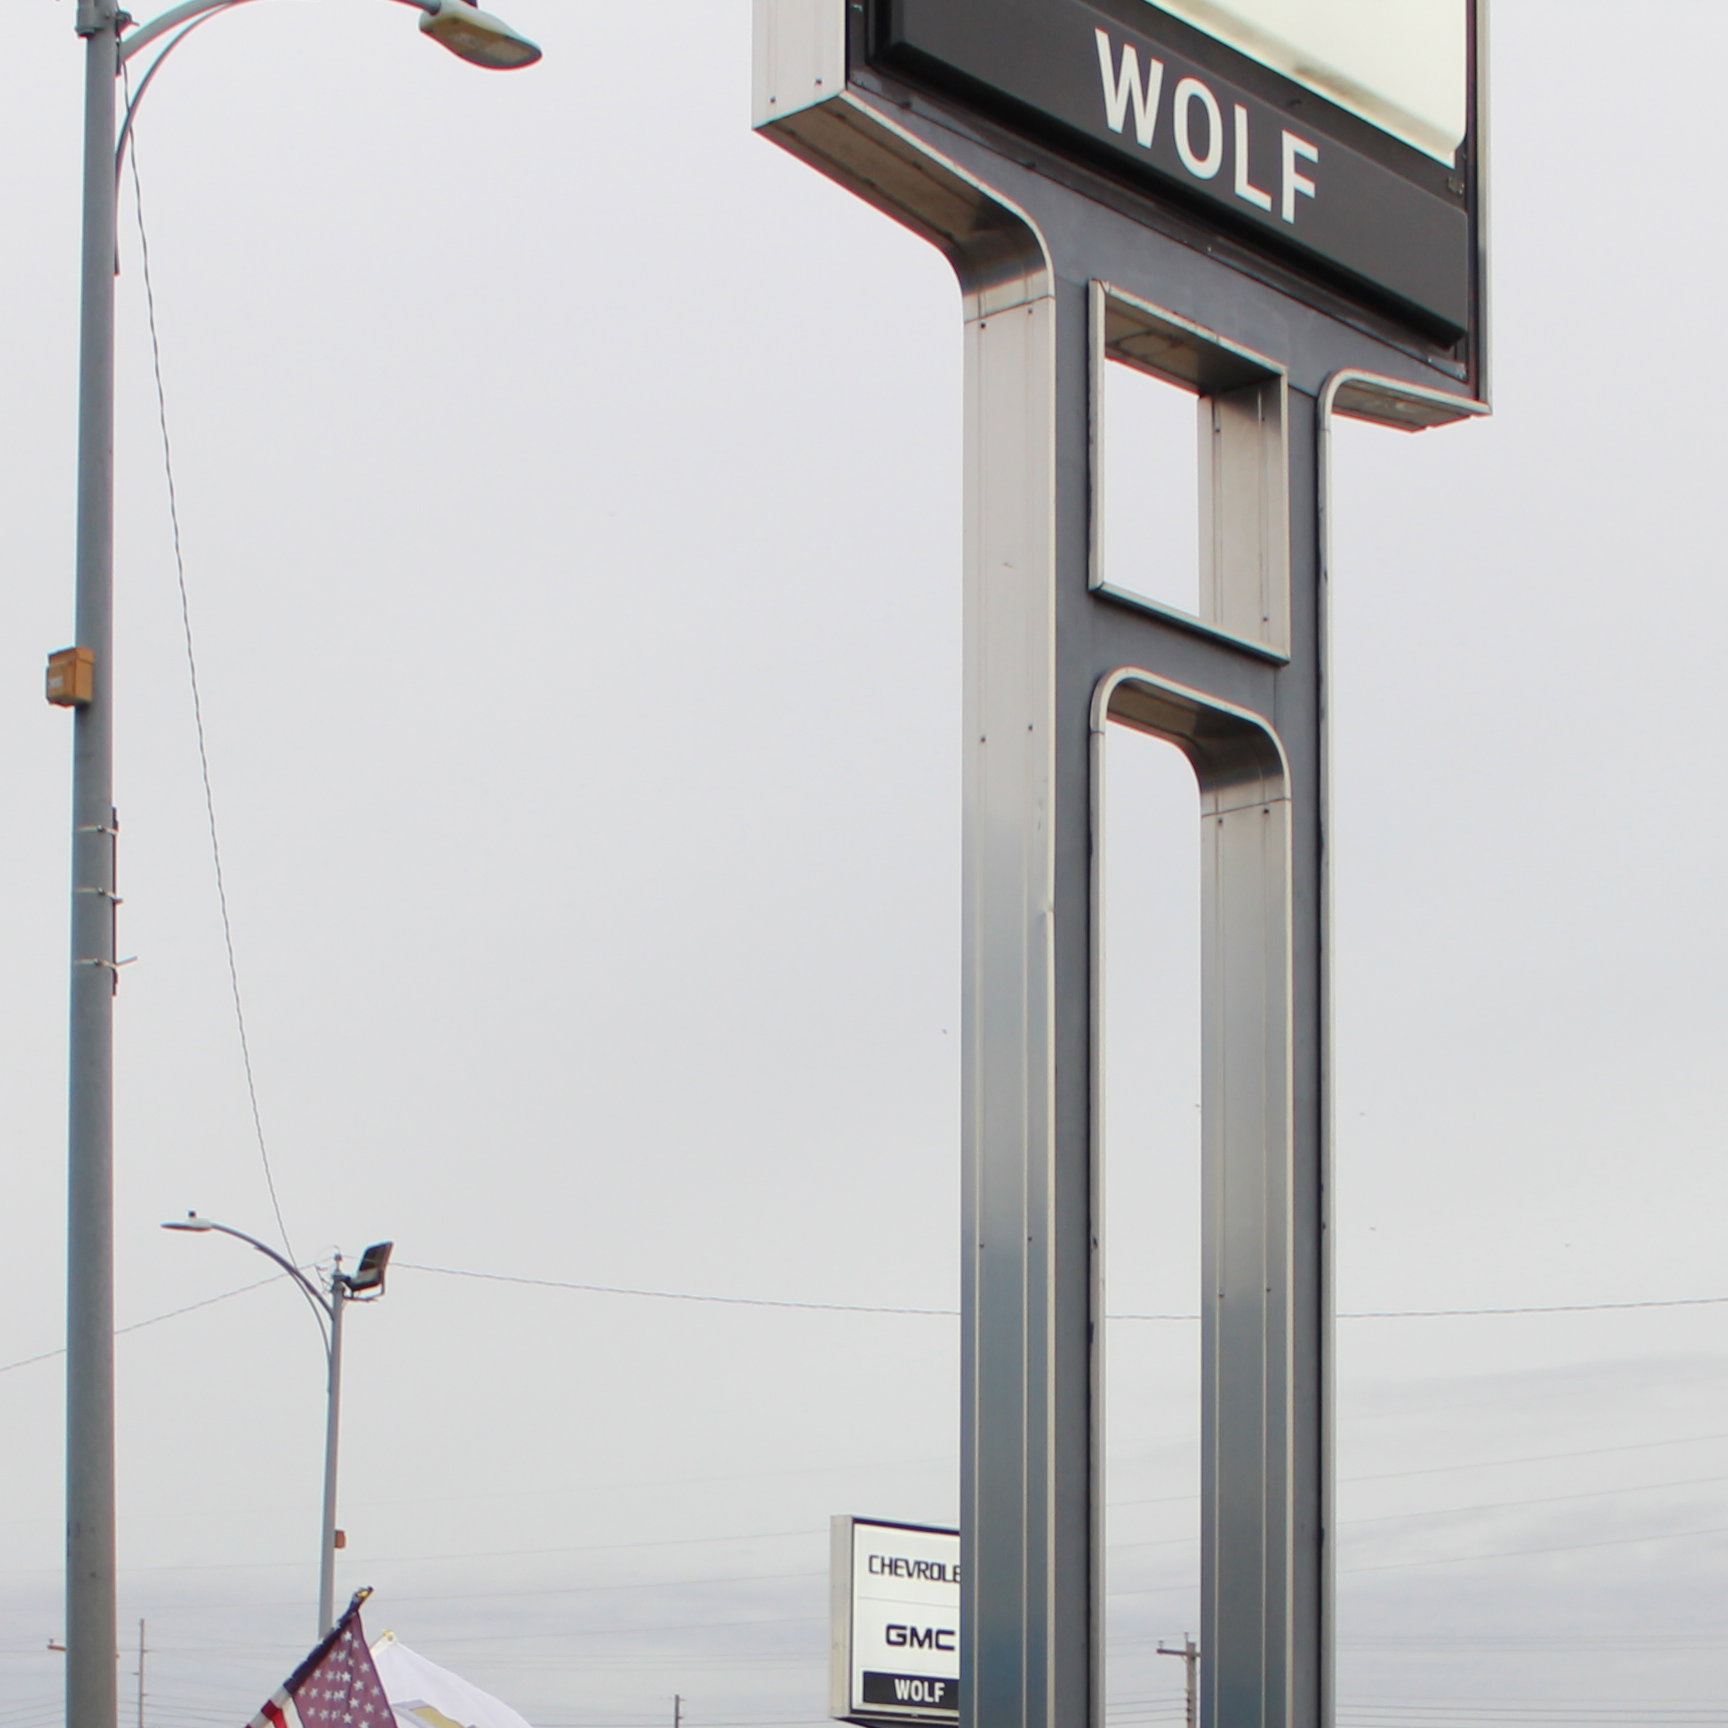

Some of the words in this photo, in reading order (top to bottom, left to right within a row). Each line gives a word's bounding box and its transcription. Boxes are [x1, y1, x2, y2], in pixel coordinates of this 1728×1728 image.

[1094, 26, 1319, 225] WOLF
[885, 1623, 956, 1651] GMC
[894, 1678, 945, 1703] WOLF
